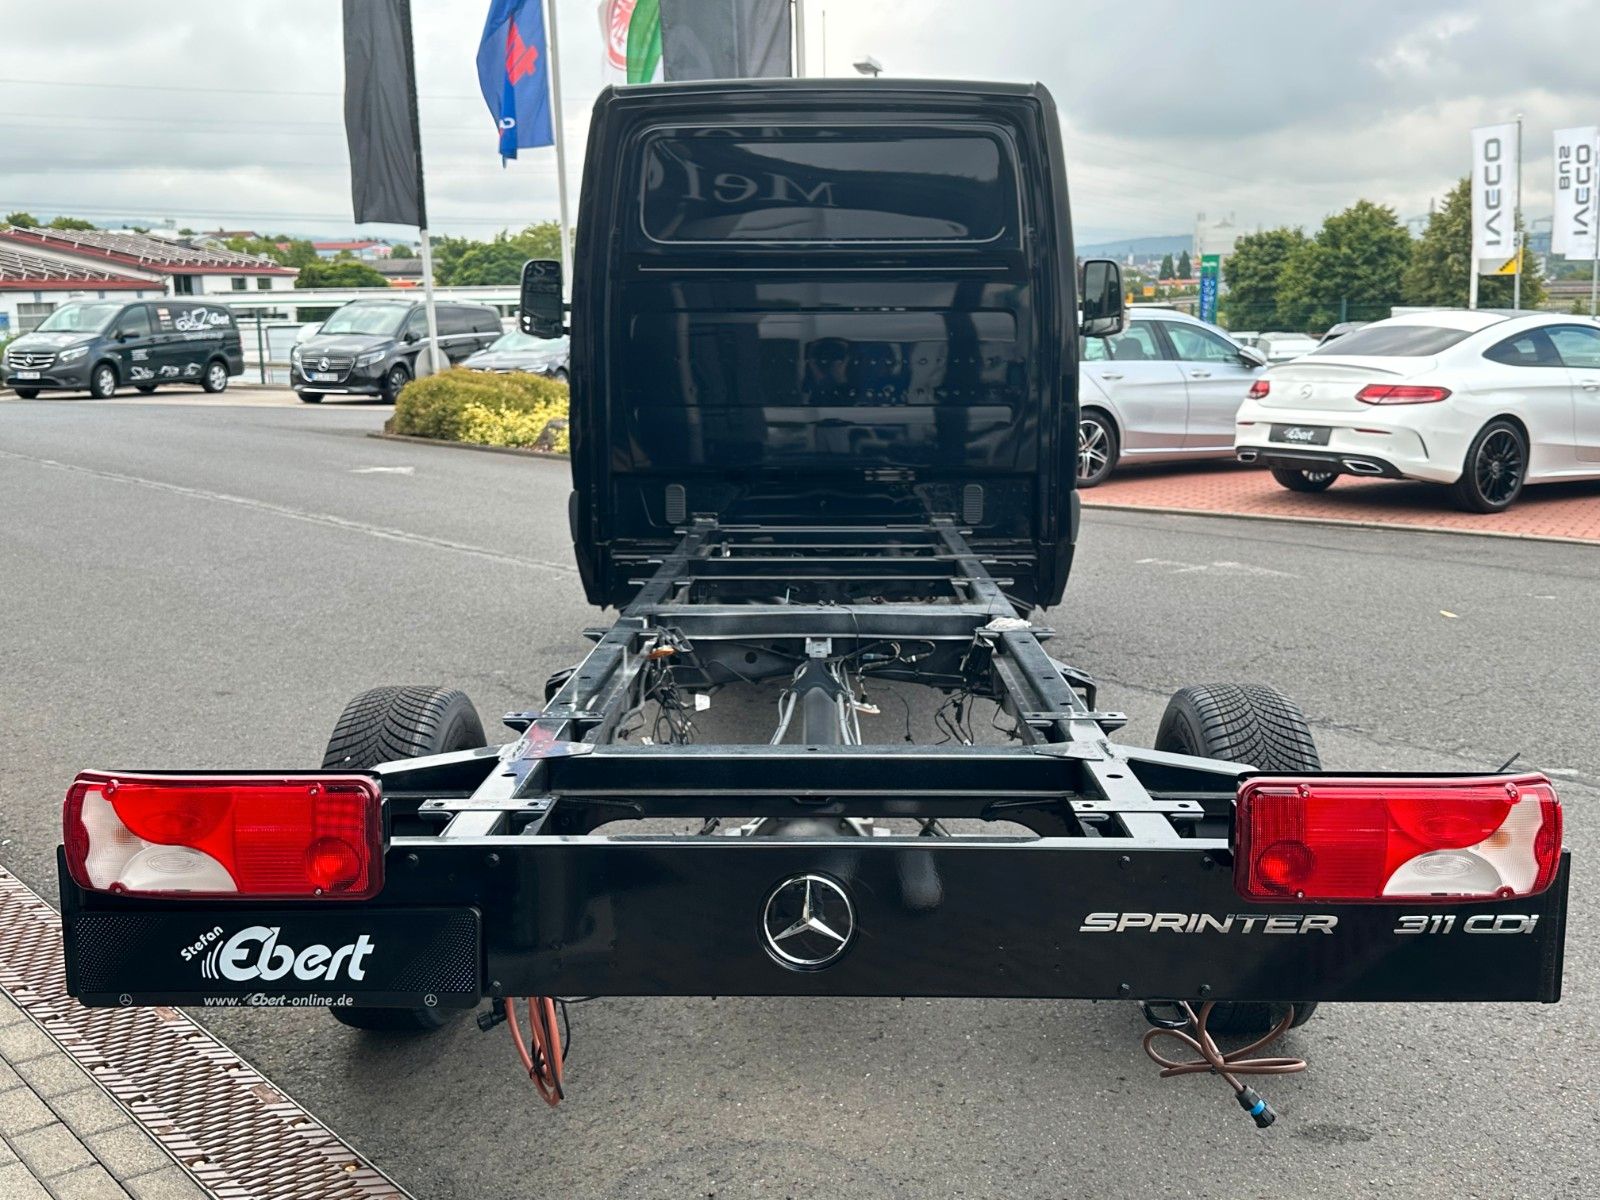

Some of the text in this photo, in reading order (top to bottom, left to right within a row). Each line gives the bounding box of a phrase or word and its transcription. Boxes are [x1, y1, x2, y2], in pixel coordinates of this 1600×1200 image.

[1079, 912, 1339, 935] SPRINTER
[1393, 914, 1457, 935] 311
[180, 925, 224, 962] Stefan
[218, 925, 375, 982] Ebert
